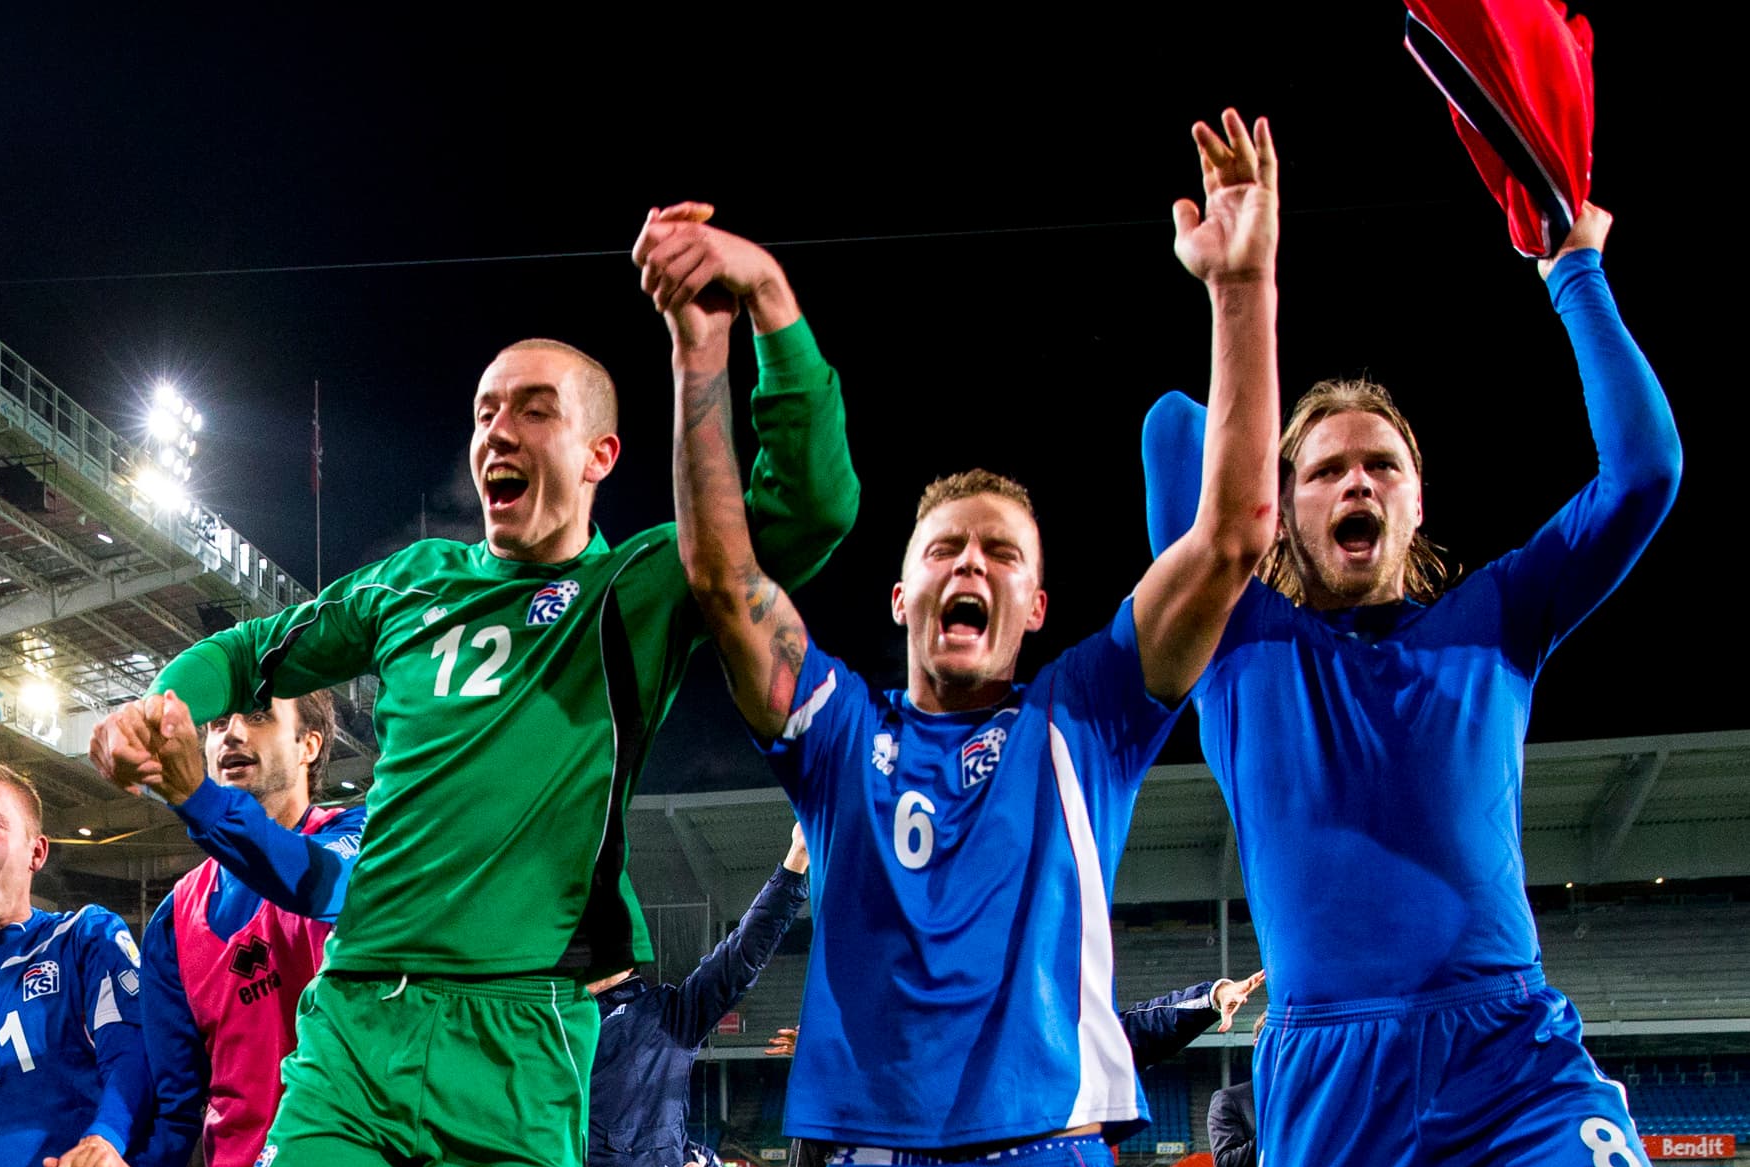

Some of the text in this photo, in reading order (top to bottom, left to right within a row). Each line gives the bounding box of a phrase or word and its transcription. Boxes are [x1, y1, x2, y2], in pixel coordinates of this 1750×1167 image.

[431, 624, 512, 697] 12
[894, 790, 936, 870] 6
[1662, 1136, 1725, 1158] Bendit
